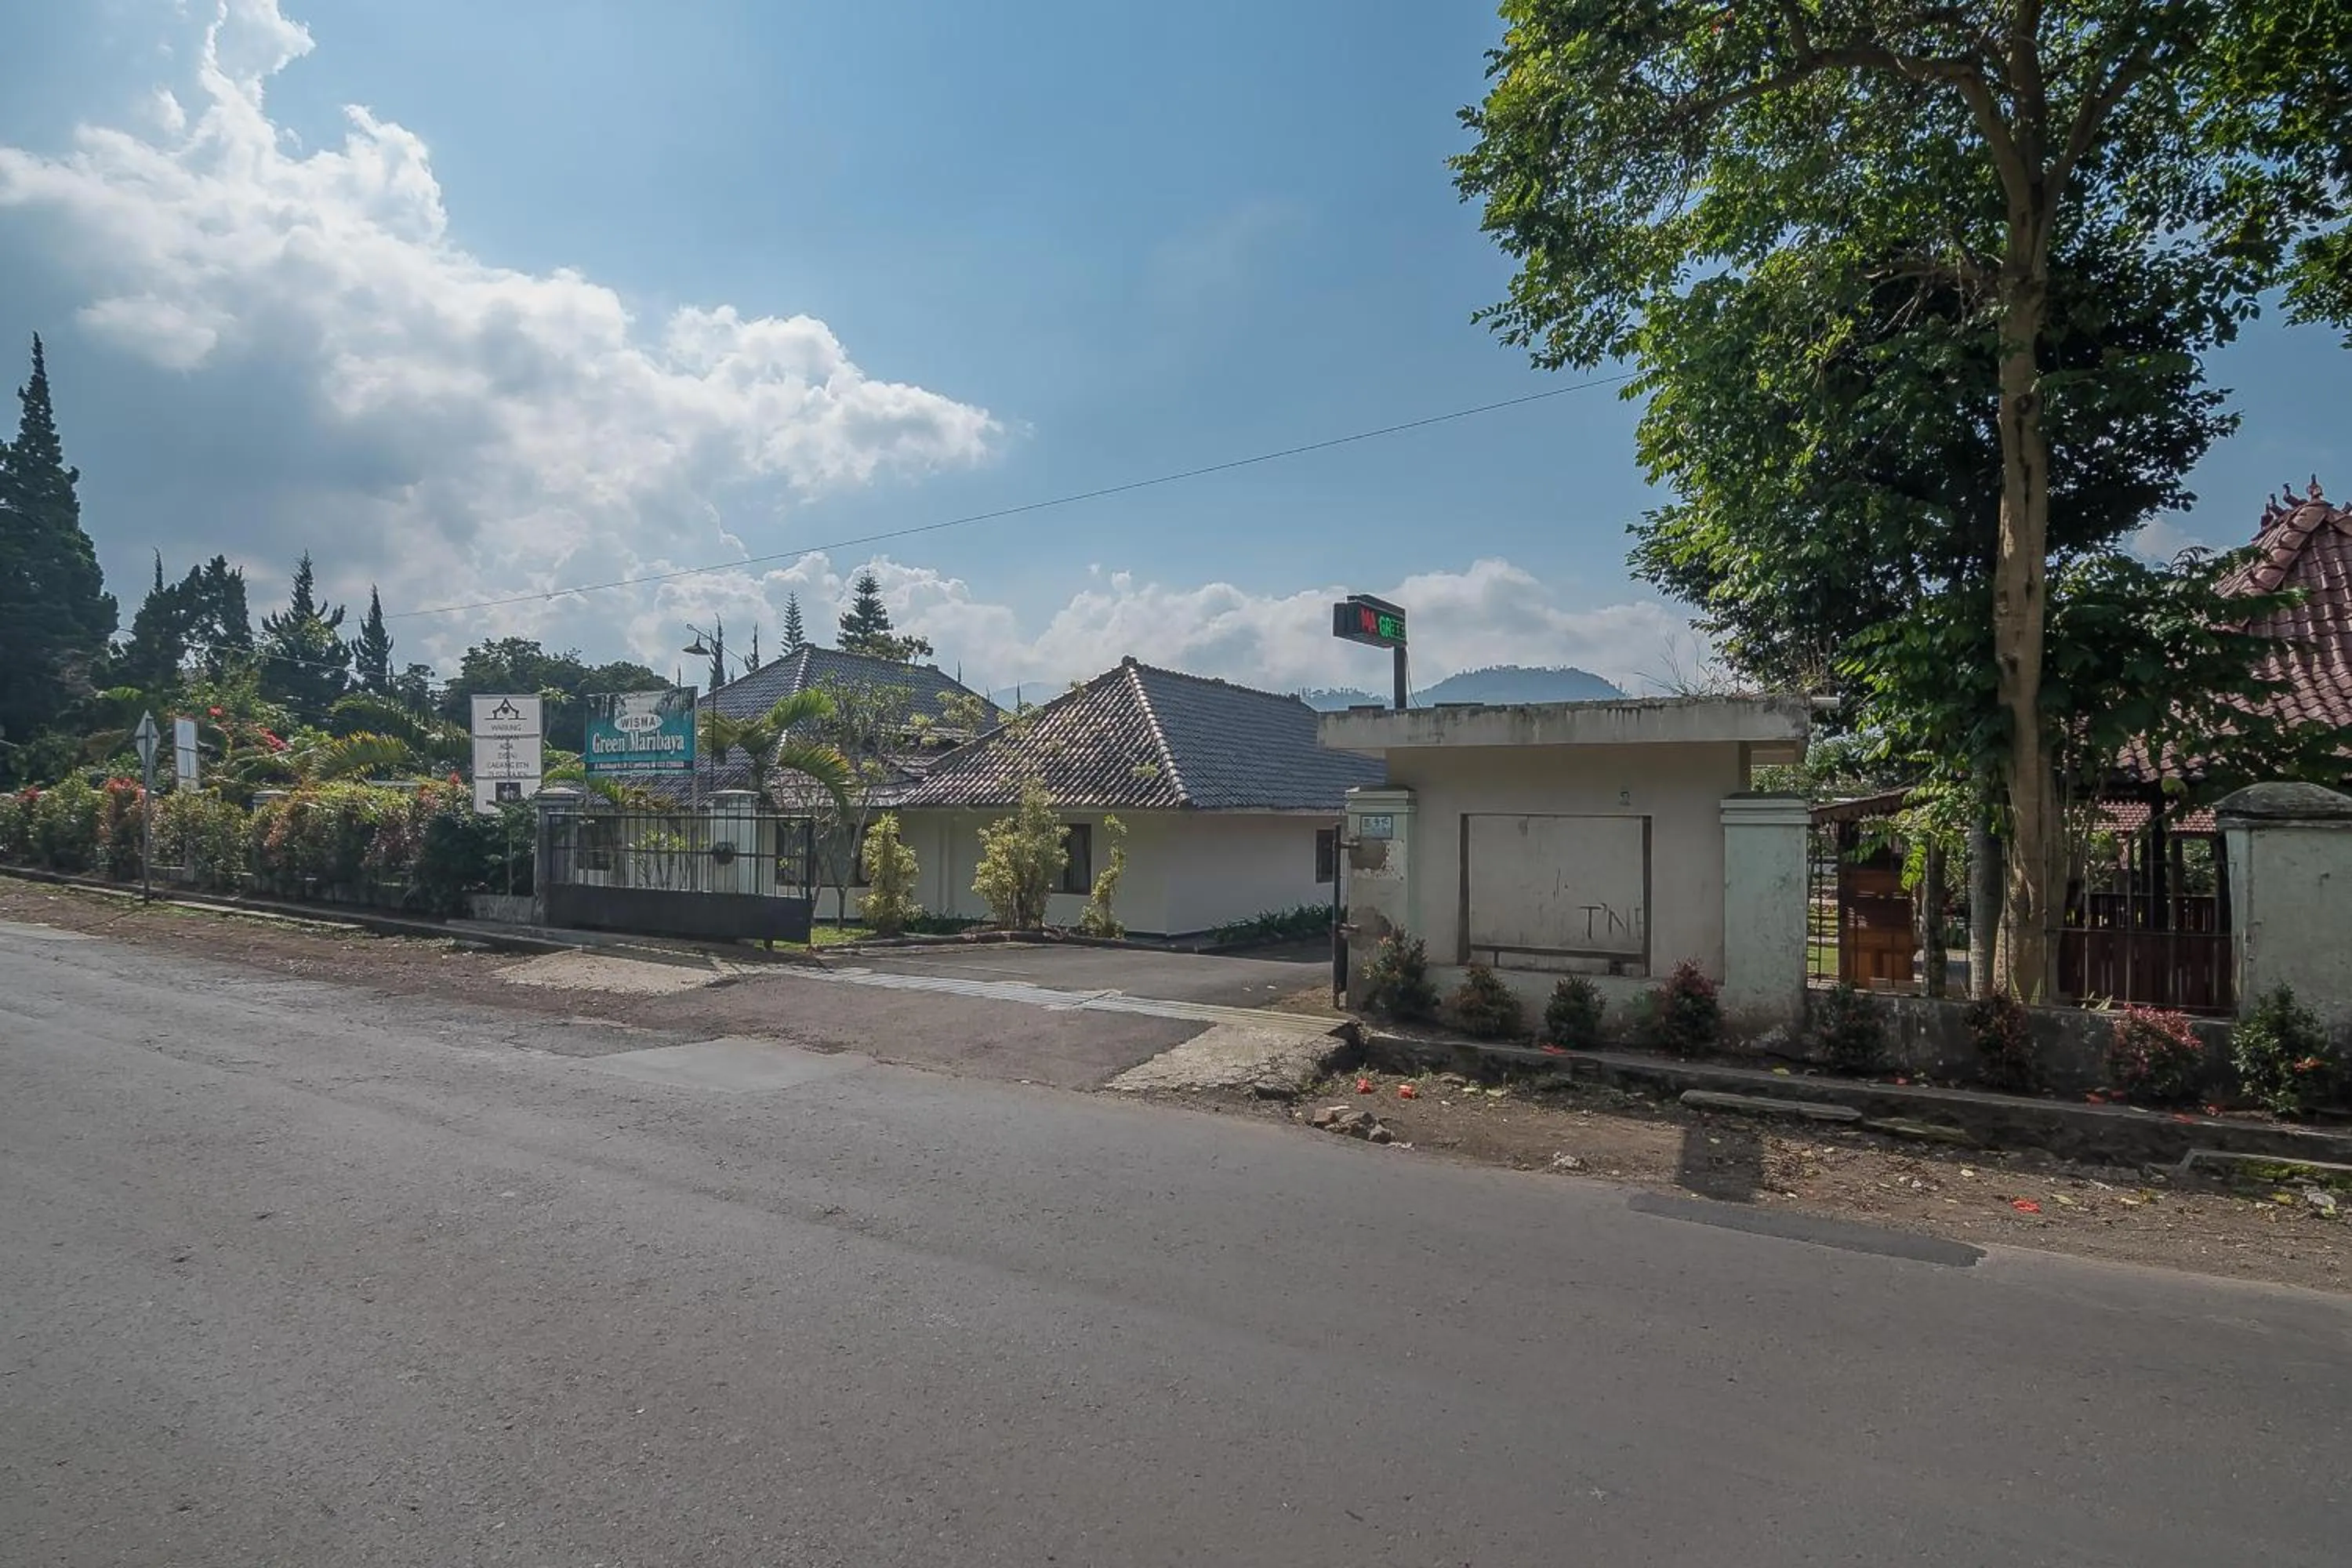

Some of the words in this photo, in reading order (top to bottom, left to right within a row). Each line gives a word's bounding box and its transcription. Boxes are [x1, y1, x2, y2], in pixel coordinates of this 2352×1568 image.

[620, 716, 657, 728] WISMA
[592, 732, 625, 753] Green
[629, 729, 685, 755] Maribaya
